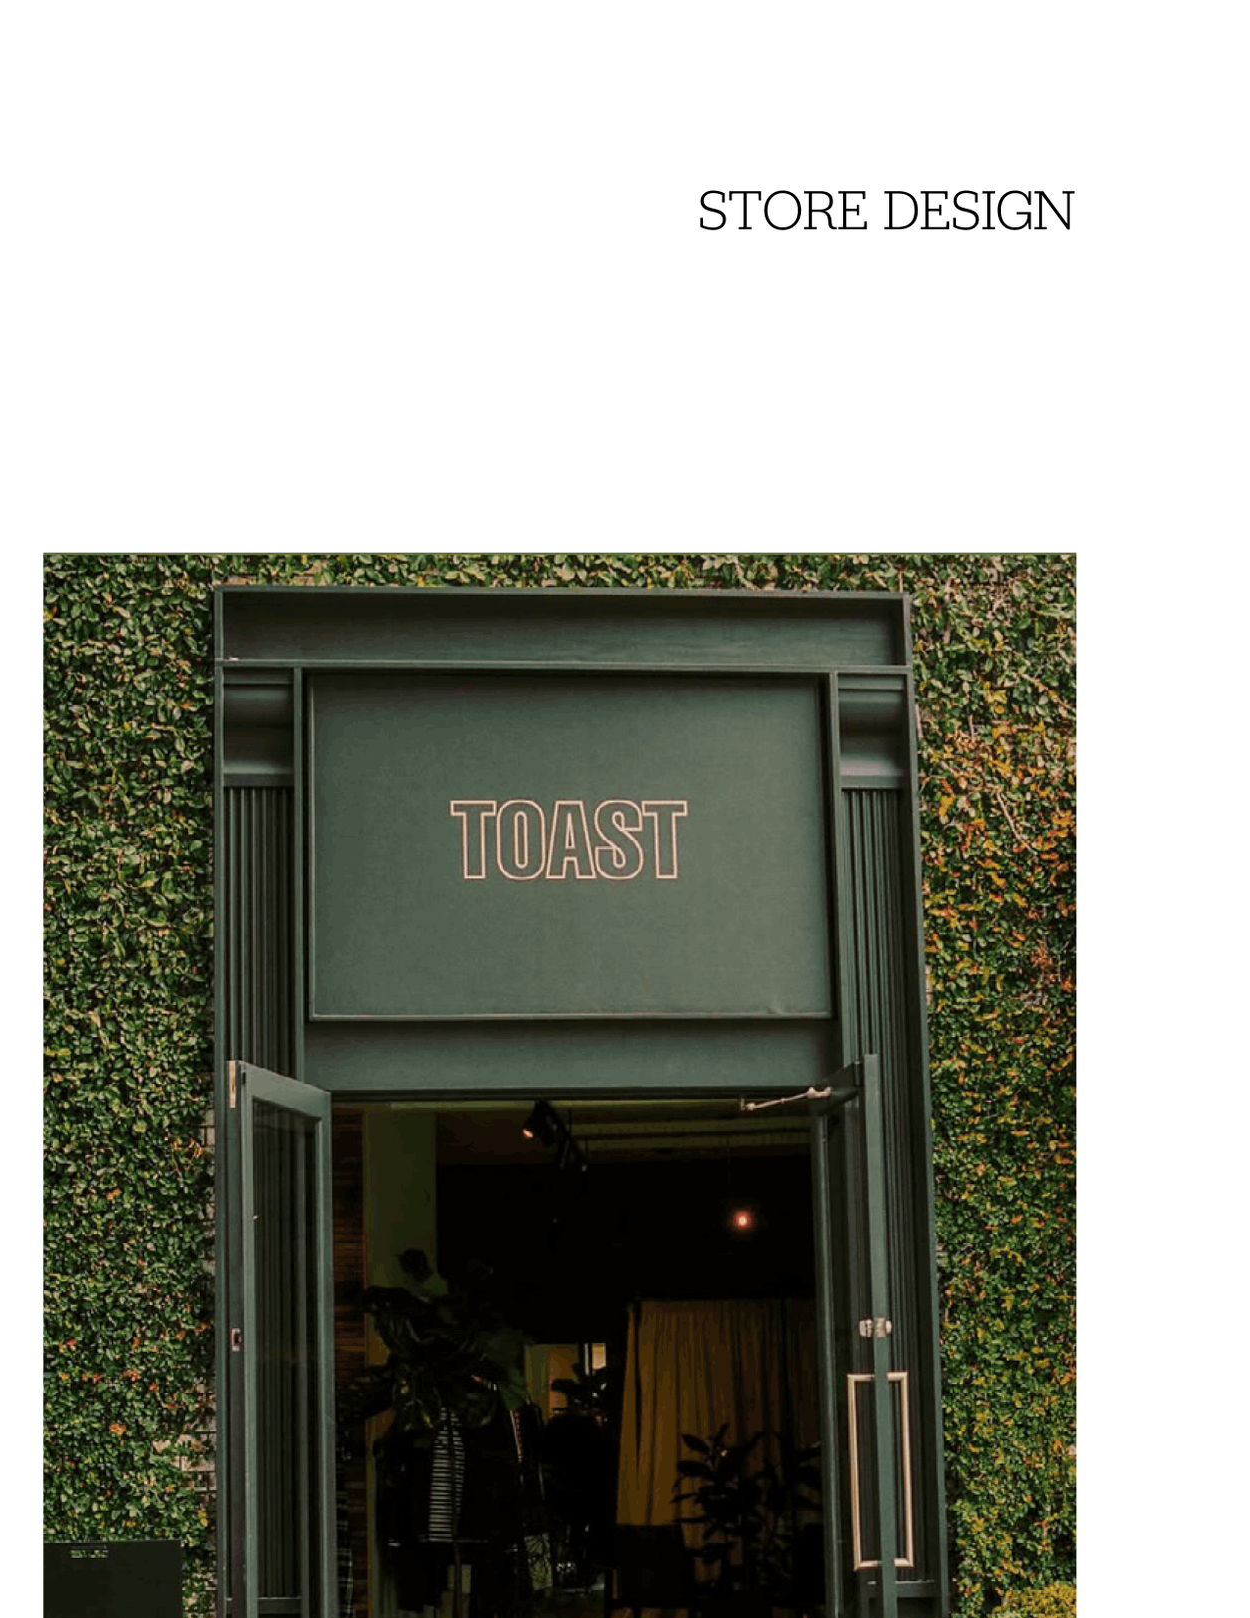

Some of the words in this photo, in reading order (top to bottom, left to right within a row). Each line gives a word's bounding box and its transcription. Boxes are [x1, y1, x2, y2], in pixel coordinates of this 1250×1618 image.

[700, 190, 867, 230] STORE
[884, 190, 1075, 230] DESIGN
[450, 798, 688, 881] TOAST
